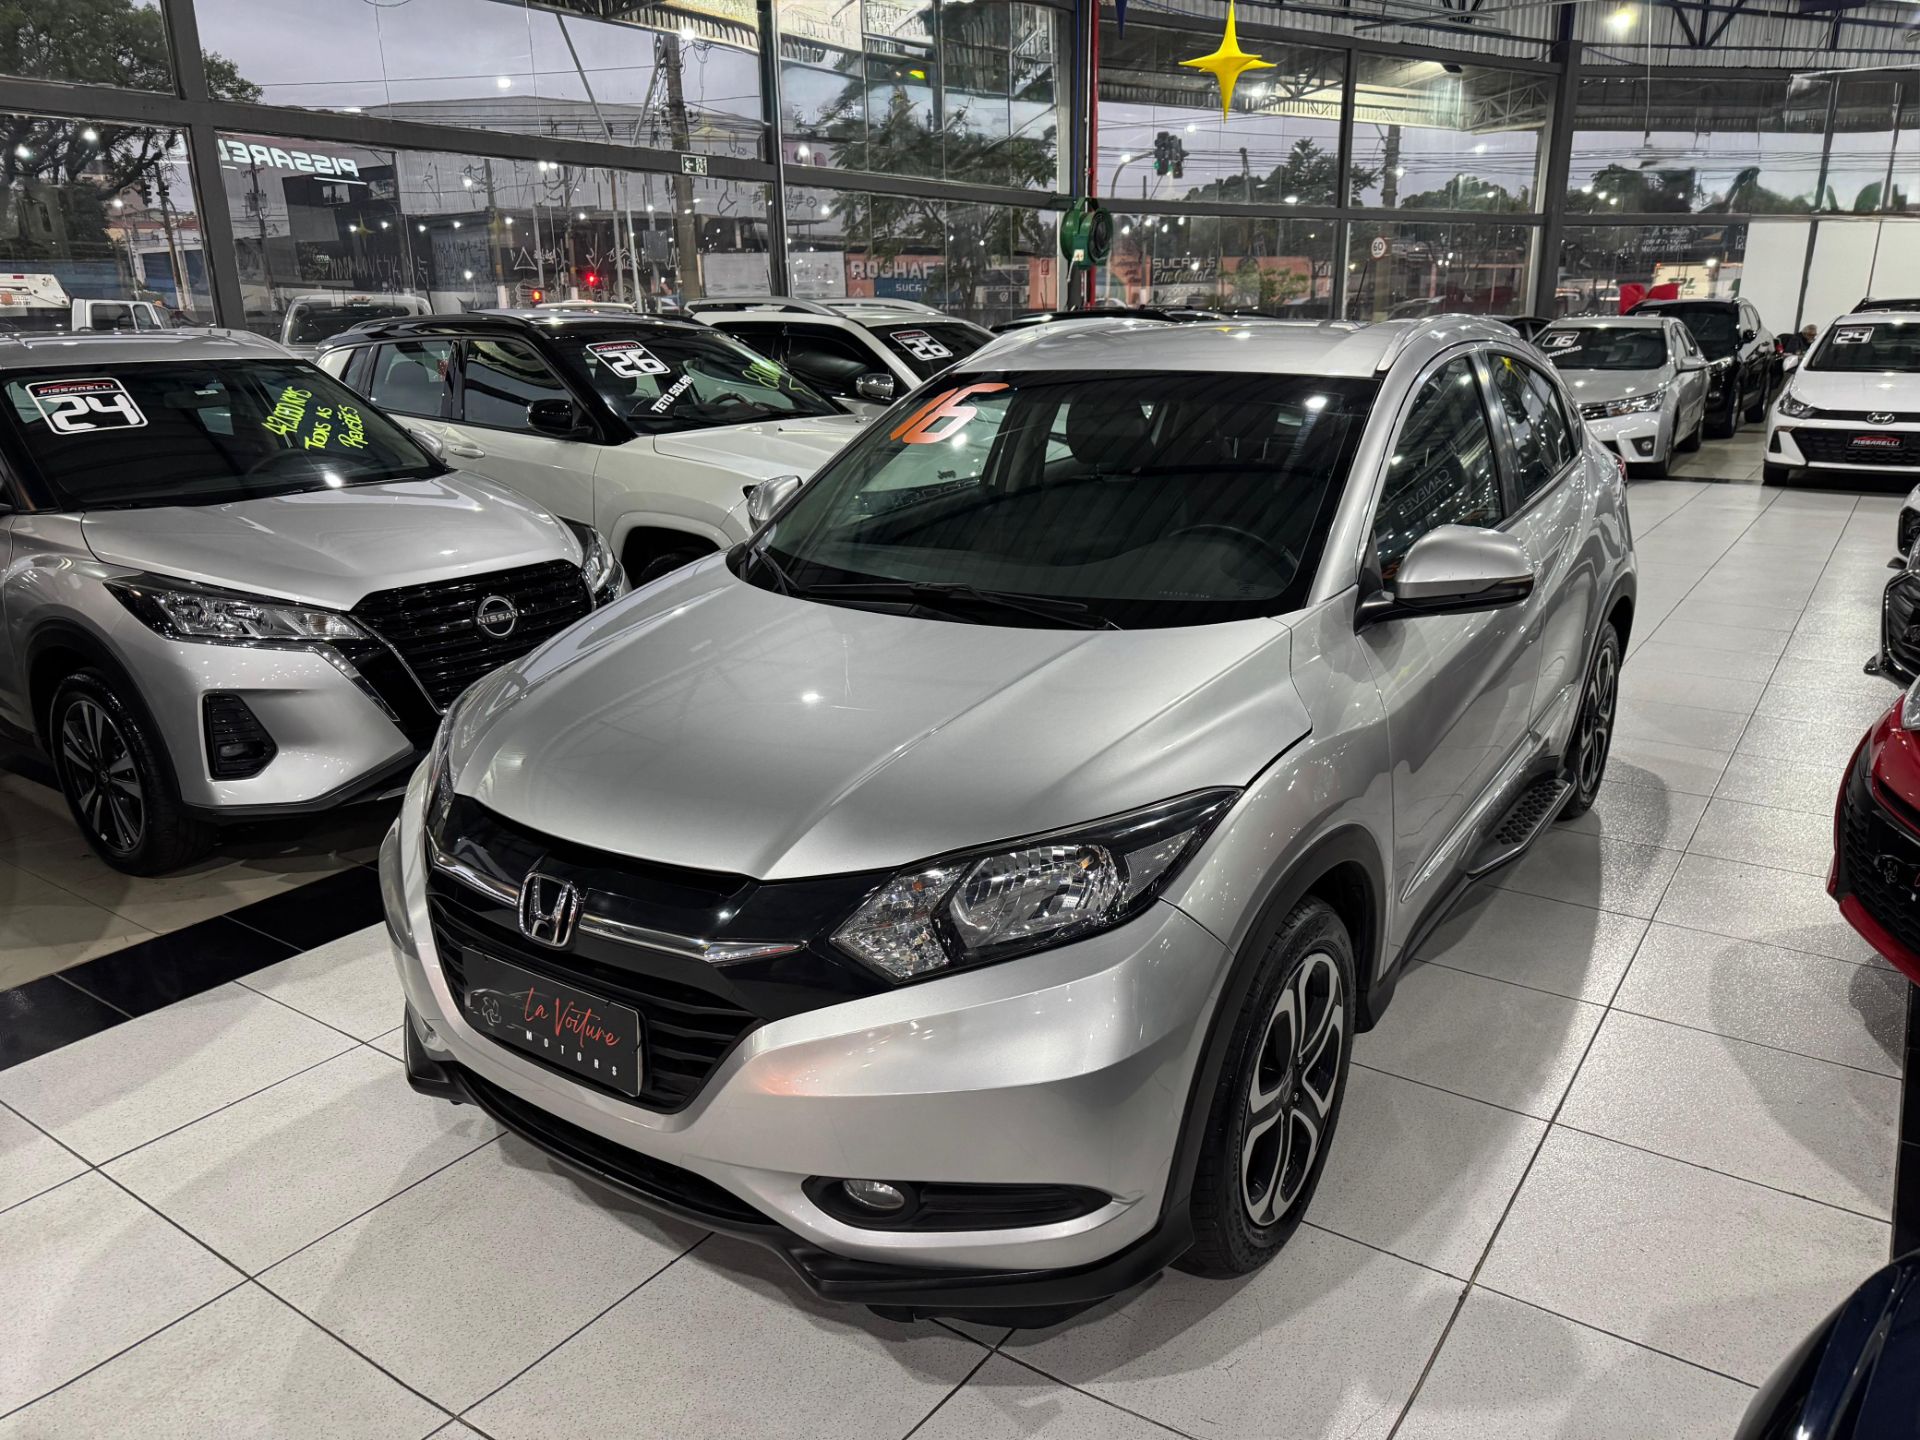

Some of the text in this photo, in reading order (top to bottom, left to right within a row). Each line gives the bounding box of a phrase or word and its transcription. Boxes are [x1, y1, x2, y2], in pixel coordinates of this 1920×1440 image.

[850, 259, 945, 280] ROCHAF
[895, 282, 928, 292] SUCA
[903, 338, 949, 358] 26
[1552, 335, 1575, 347] 16
[1836, 331, 1870, 343] 24
[602, 350, 666, 376] 26
[650, 374, 695, 414] TETO SOLAR
[44, 394, 140, 431] 24
[890, 382, 1010, 444] 16
[477, 608, 519, 625] NISSAN
[523, 986, 621, 1049] La Voiture
[525, 1030, 617, 1077] MOTORS
